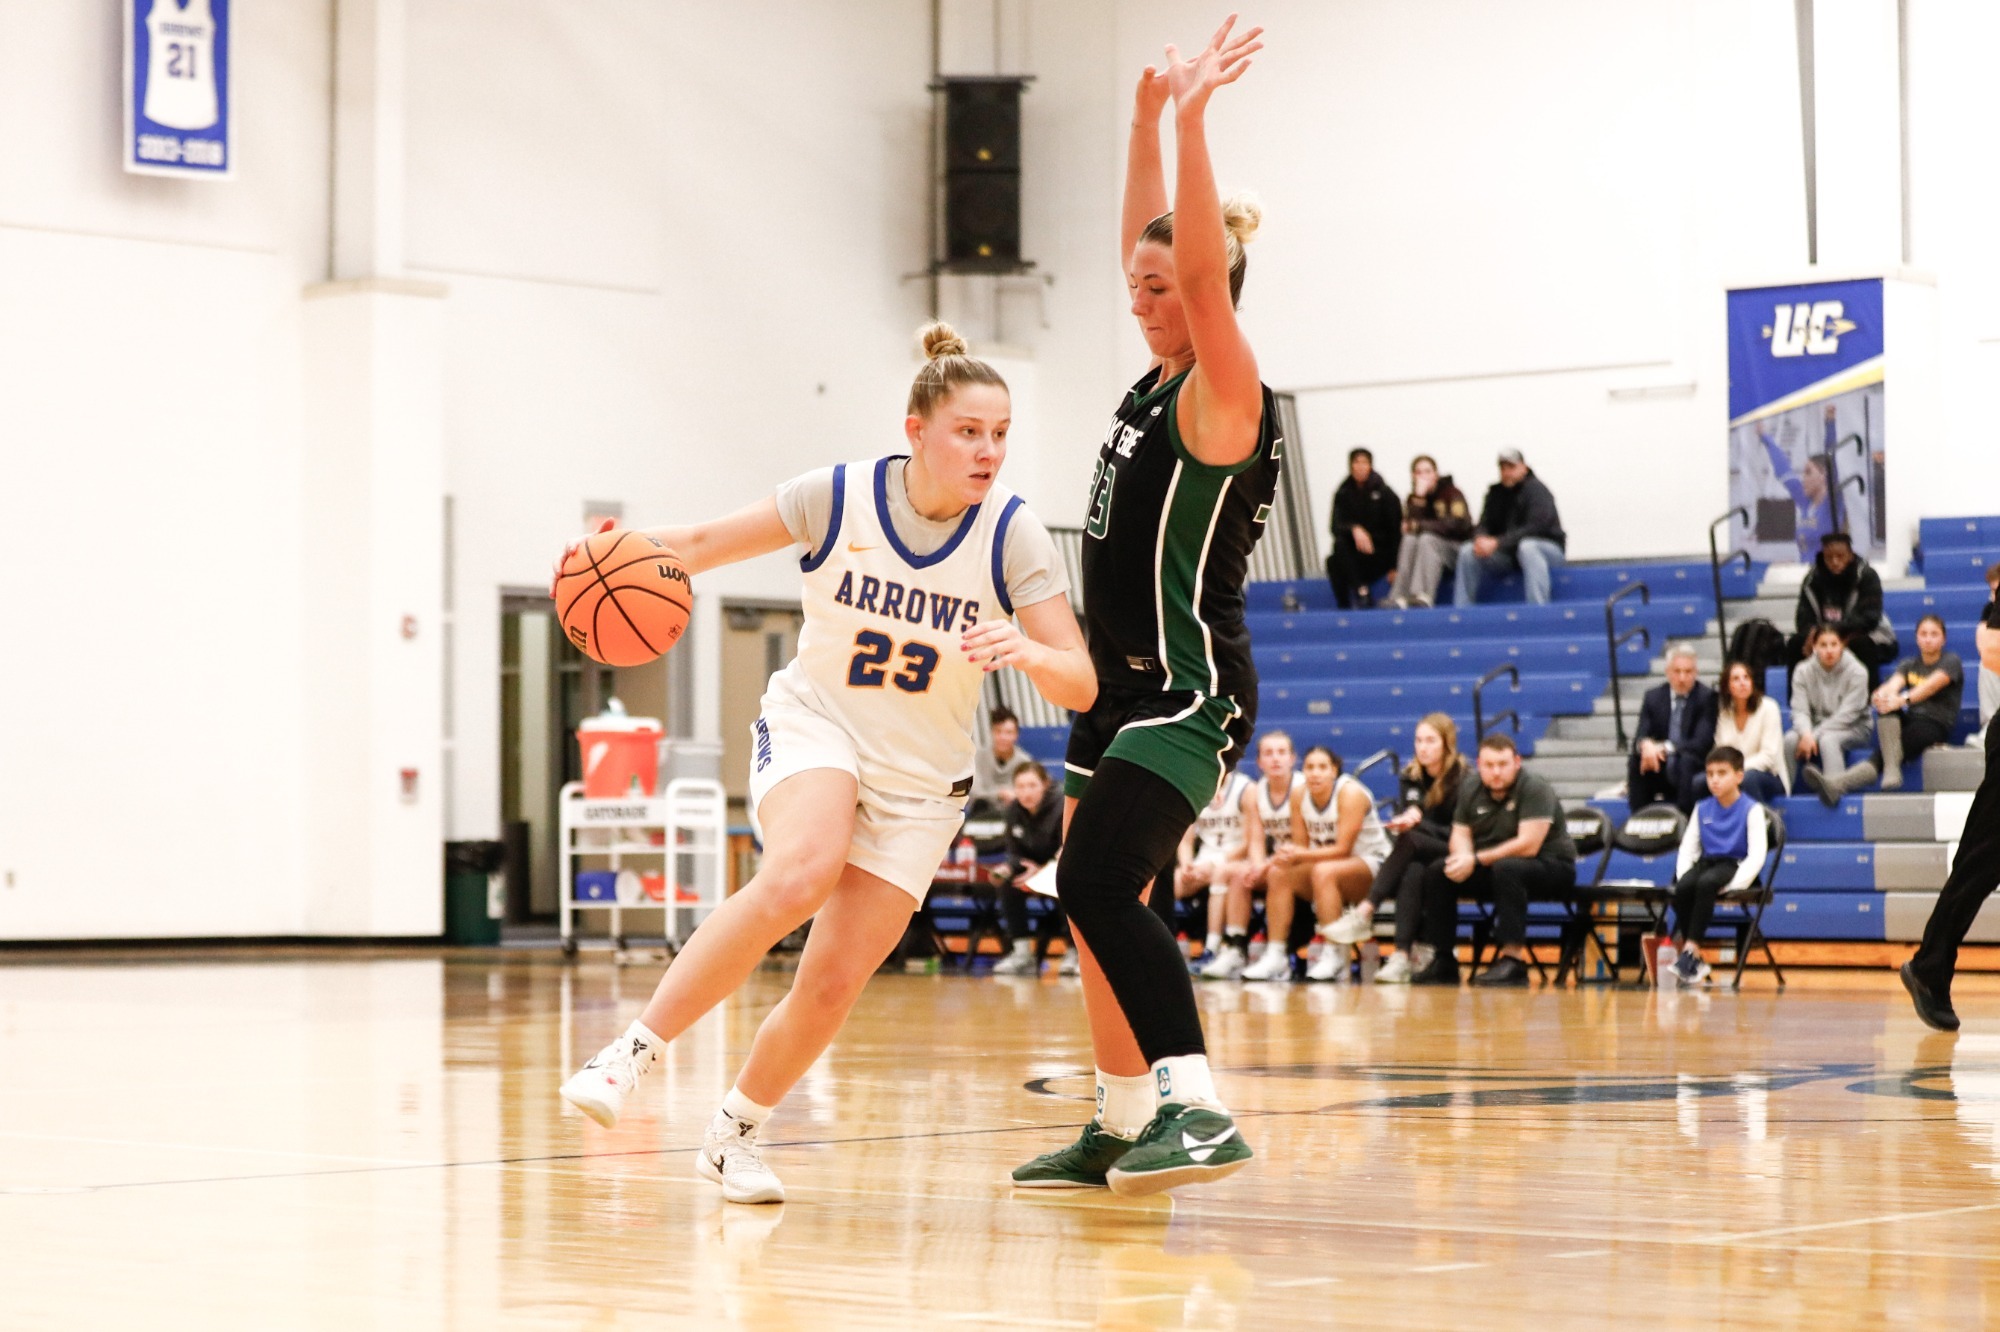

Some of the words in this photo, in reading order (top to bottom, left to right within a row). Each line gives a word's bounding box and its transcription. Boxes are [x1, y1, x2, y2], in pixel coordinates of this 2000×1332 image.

[167, 42, 195, 79] 21
[1771, 300, 1843, 357] UC
[834, 570, 980, 633] ARROWS
[846, 627, 942, 694] 23
[584, 805, 648, 819] GATORADE
